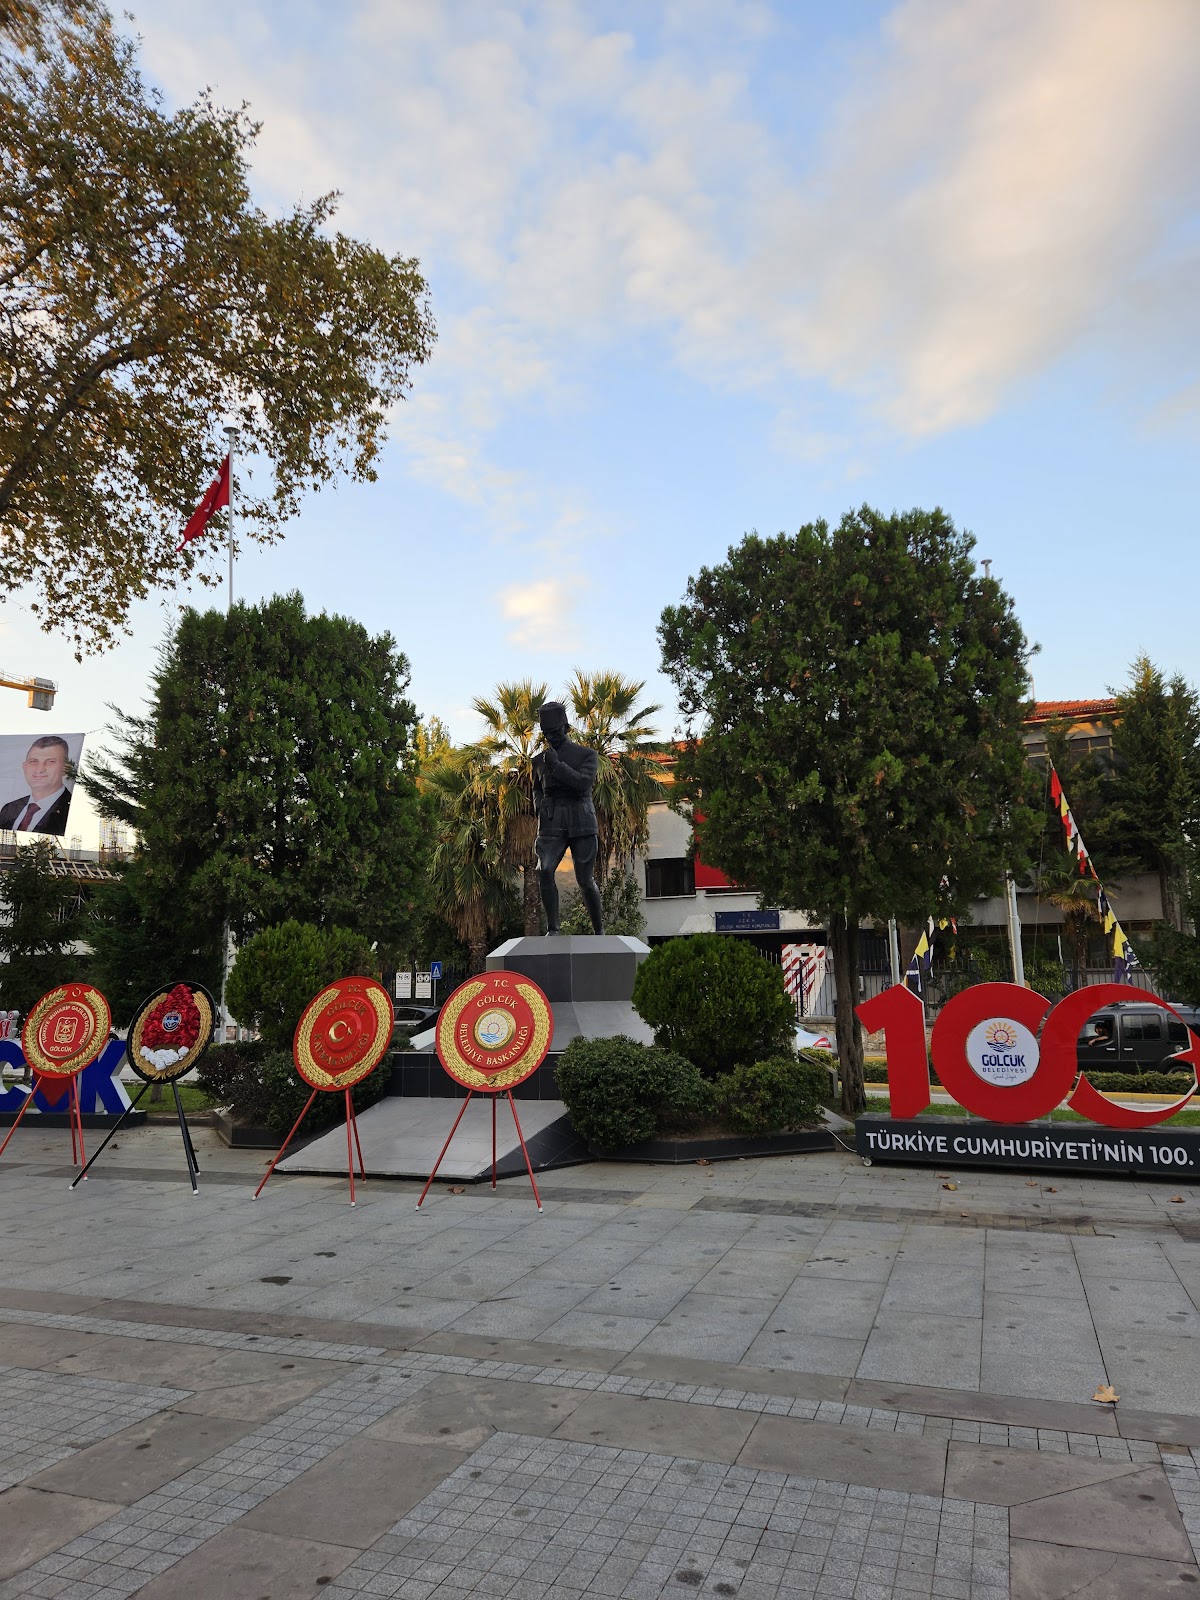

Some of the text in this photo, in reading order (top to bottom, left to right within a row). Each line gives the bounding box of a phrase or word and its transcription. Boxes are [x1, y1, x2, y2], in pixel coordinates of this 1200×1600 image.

[476, 995, 519, 1009] GÖLCÜK
[49, 1045, 73, 1053] GÖLCÜK
[460, 1023, 529, 1065] BELEDİYE BAŞKANLIĞI
[982, 1054, 1026, 1067] GÖLCÜK
[865, 1129, 949, 1153] TÜRKİYE
[1149, 1146, 1194, 1166] 100.
